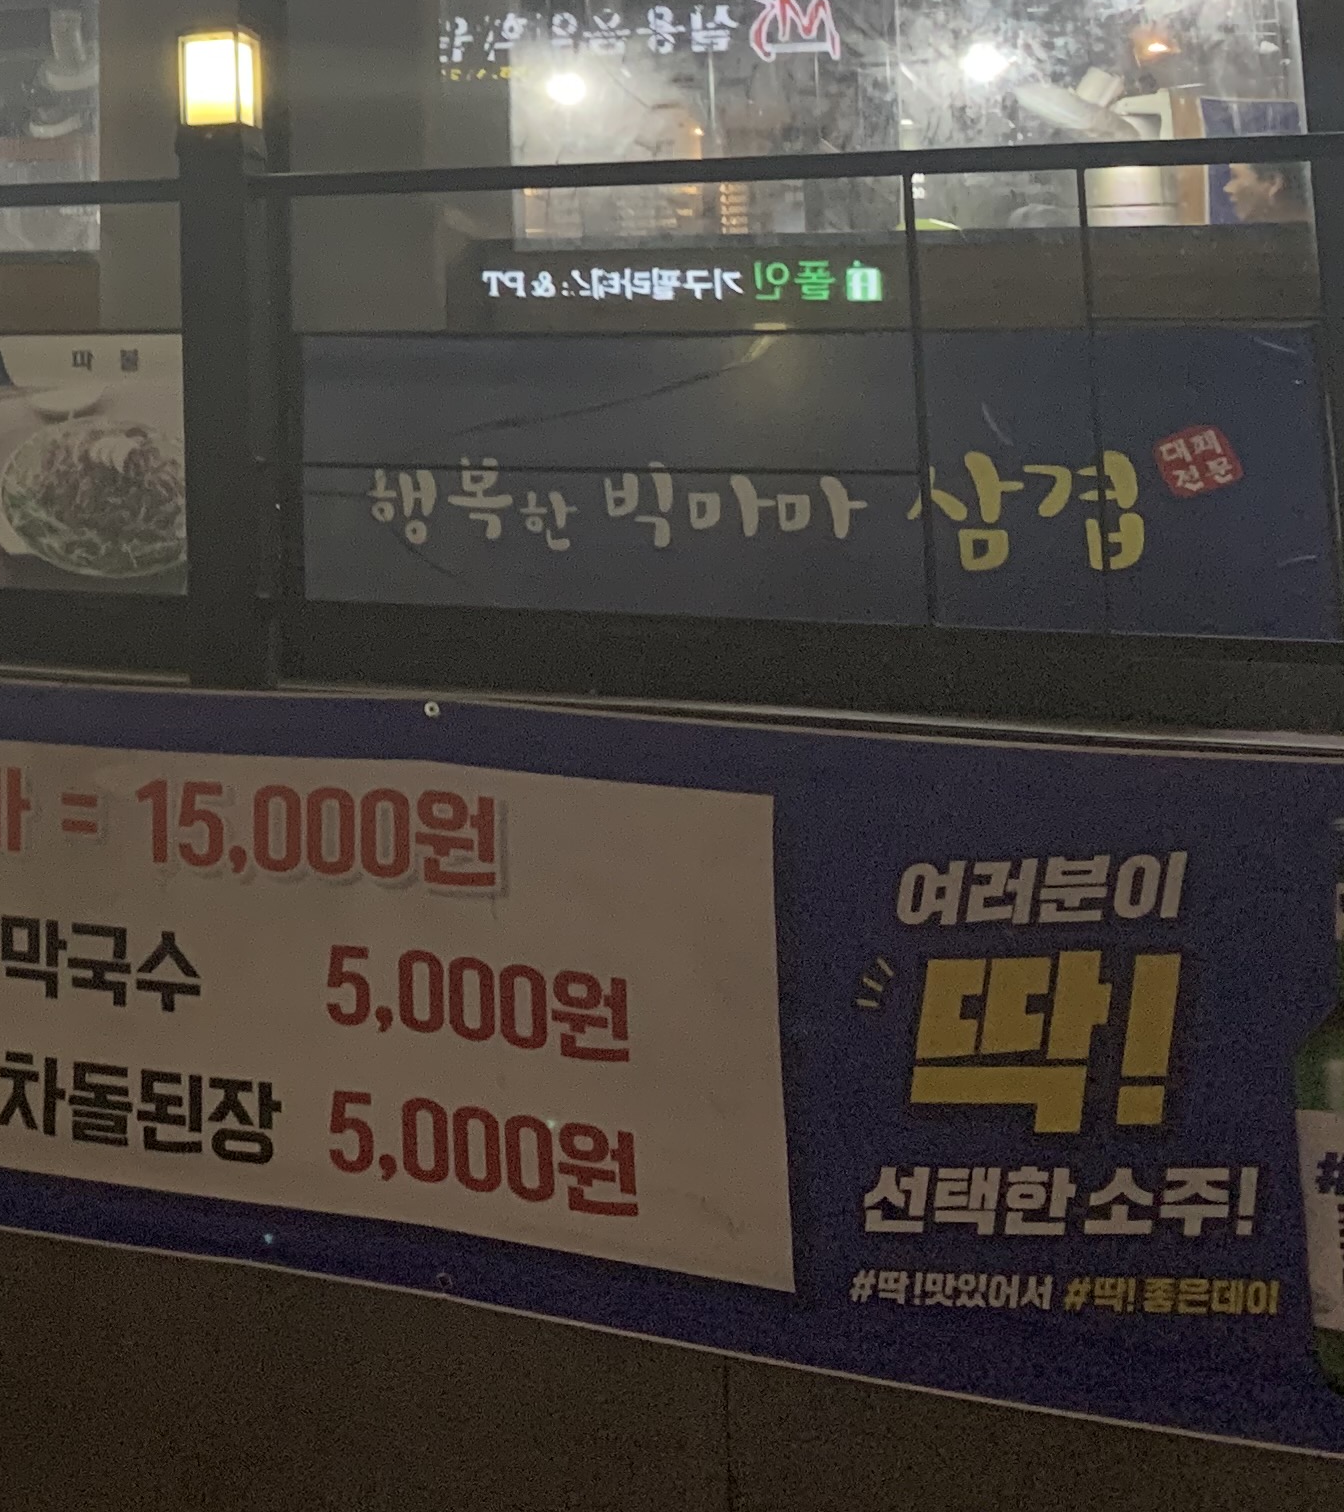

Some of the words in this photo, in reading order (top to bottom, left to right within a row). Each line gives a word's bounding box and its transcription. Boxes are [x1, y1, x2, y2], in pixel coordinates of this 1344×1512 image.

[1161, 429, 1224, 463] 대패
[1173, 458, 1232, 491] 전문
[370, 456, 579, 551] 행복한
[604, 460, 866, 550] 빅마마
[909, 450, 1145, 571] 삼겹
[135, 778, 496, 888] 15,000원
[896, 852, 1188, 927] 여러분이
[0, 914, 201, 1013] 막국수
[325, 943, 630, 1063] 5,000원
[911, 949, 1182, 1133] 딱!
[327, 1090, 639, 1218] 5,000원
[864, 1166, 1076, 1236] 선택한
[1083, 1166, 1258, 1237] 소주!
[1143, 1277, 1280, 1316] 좋은데이
